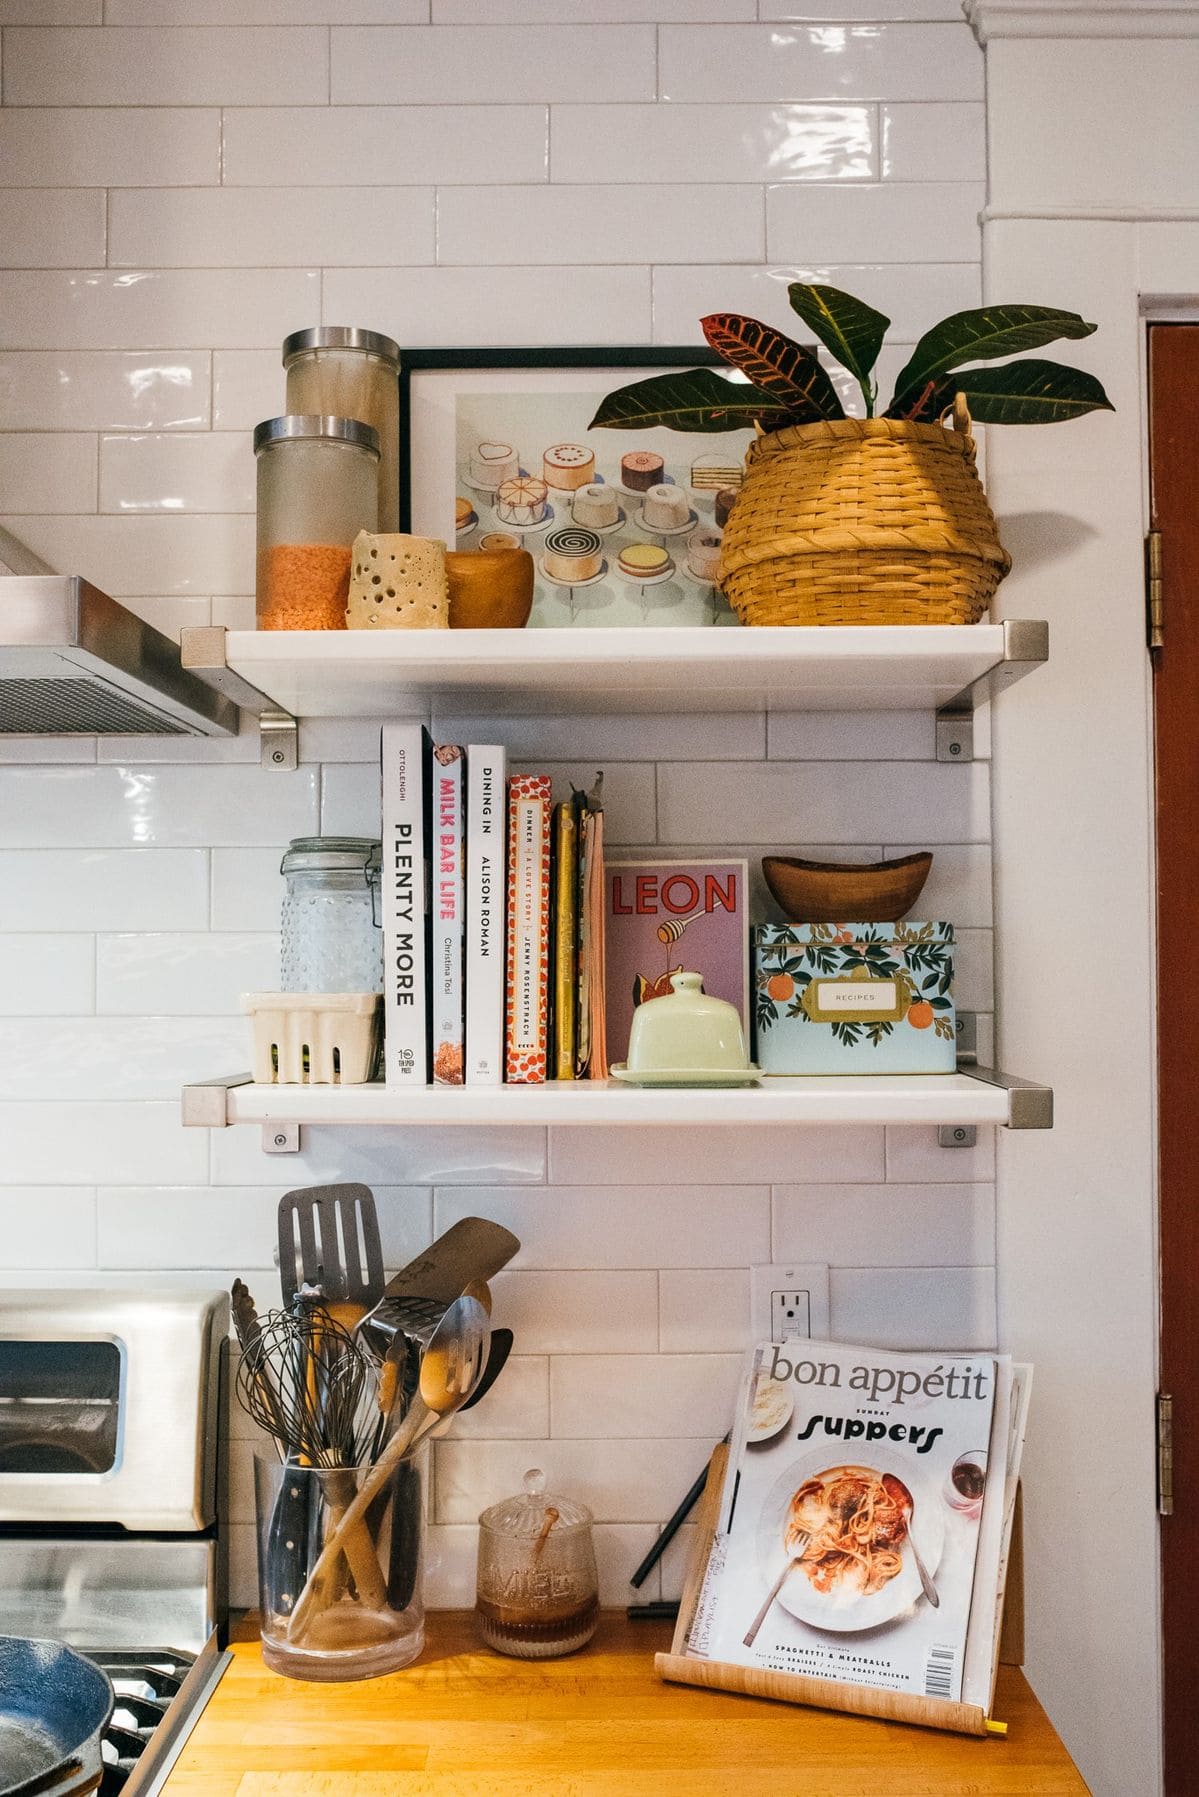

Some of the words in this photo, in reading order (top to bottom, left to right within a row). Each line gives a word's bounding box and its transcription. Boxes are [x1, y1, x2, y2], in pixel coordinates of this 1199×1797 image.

[439, 778, 456, 827] MILK
[482, 767, 492, 816] DINING
[482, 820, 491, 834] IN
[395, 824, 413, 922] PLENTY
[440, 834, 456, 873] BAR
[440, 881, 456, 920] LIFE
[481, 856, 490, 905] ALISON
[612, 874, 736, 915] LEON
[480, 909, 490, 957] ROMAN
[396, 933, 414, 1006] MORE
[445, 937, 453, 977] Christina
[444, 978, 452, 995] Tosi
[523, 969, 531, 1037] ROSENSTRACH
[769, 1346, 841, 1387] bon
[849, 1365, 988, 1404] appétit
[856, 1408, 891, 1416] SUNDAY
[775, 1645, 824, 1657] SPAGHETTI
[838, 1654, 891, 1668] MEATBALLS
[798, 1668, 837, 1679] ENTERTAIN
[852, 1667, 876, 1675] ROAST
[878, 1671, 910, 1680] CHICKEN
